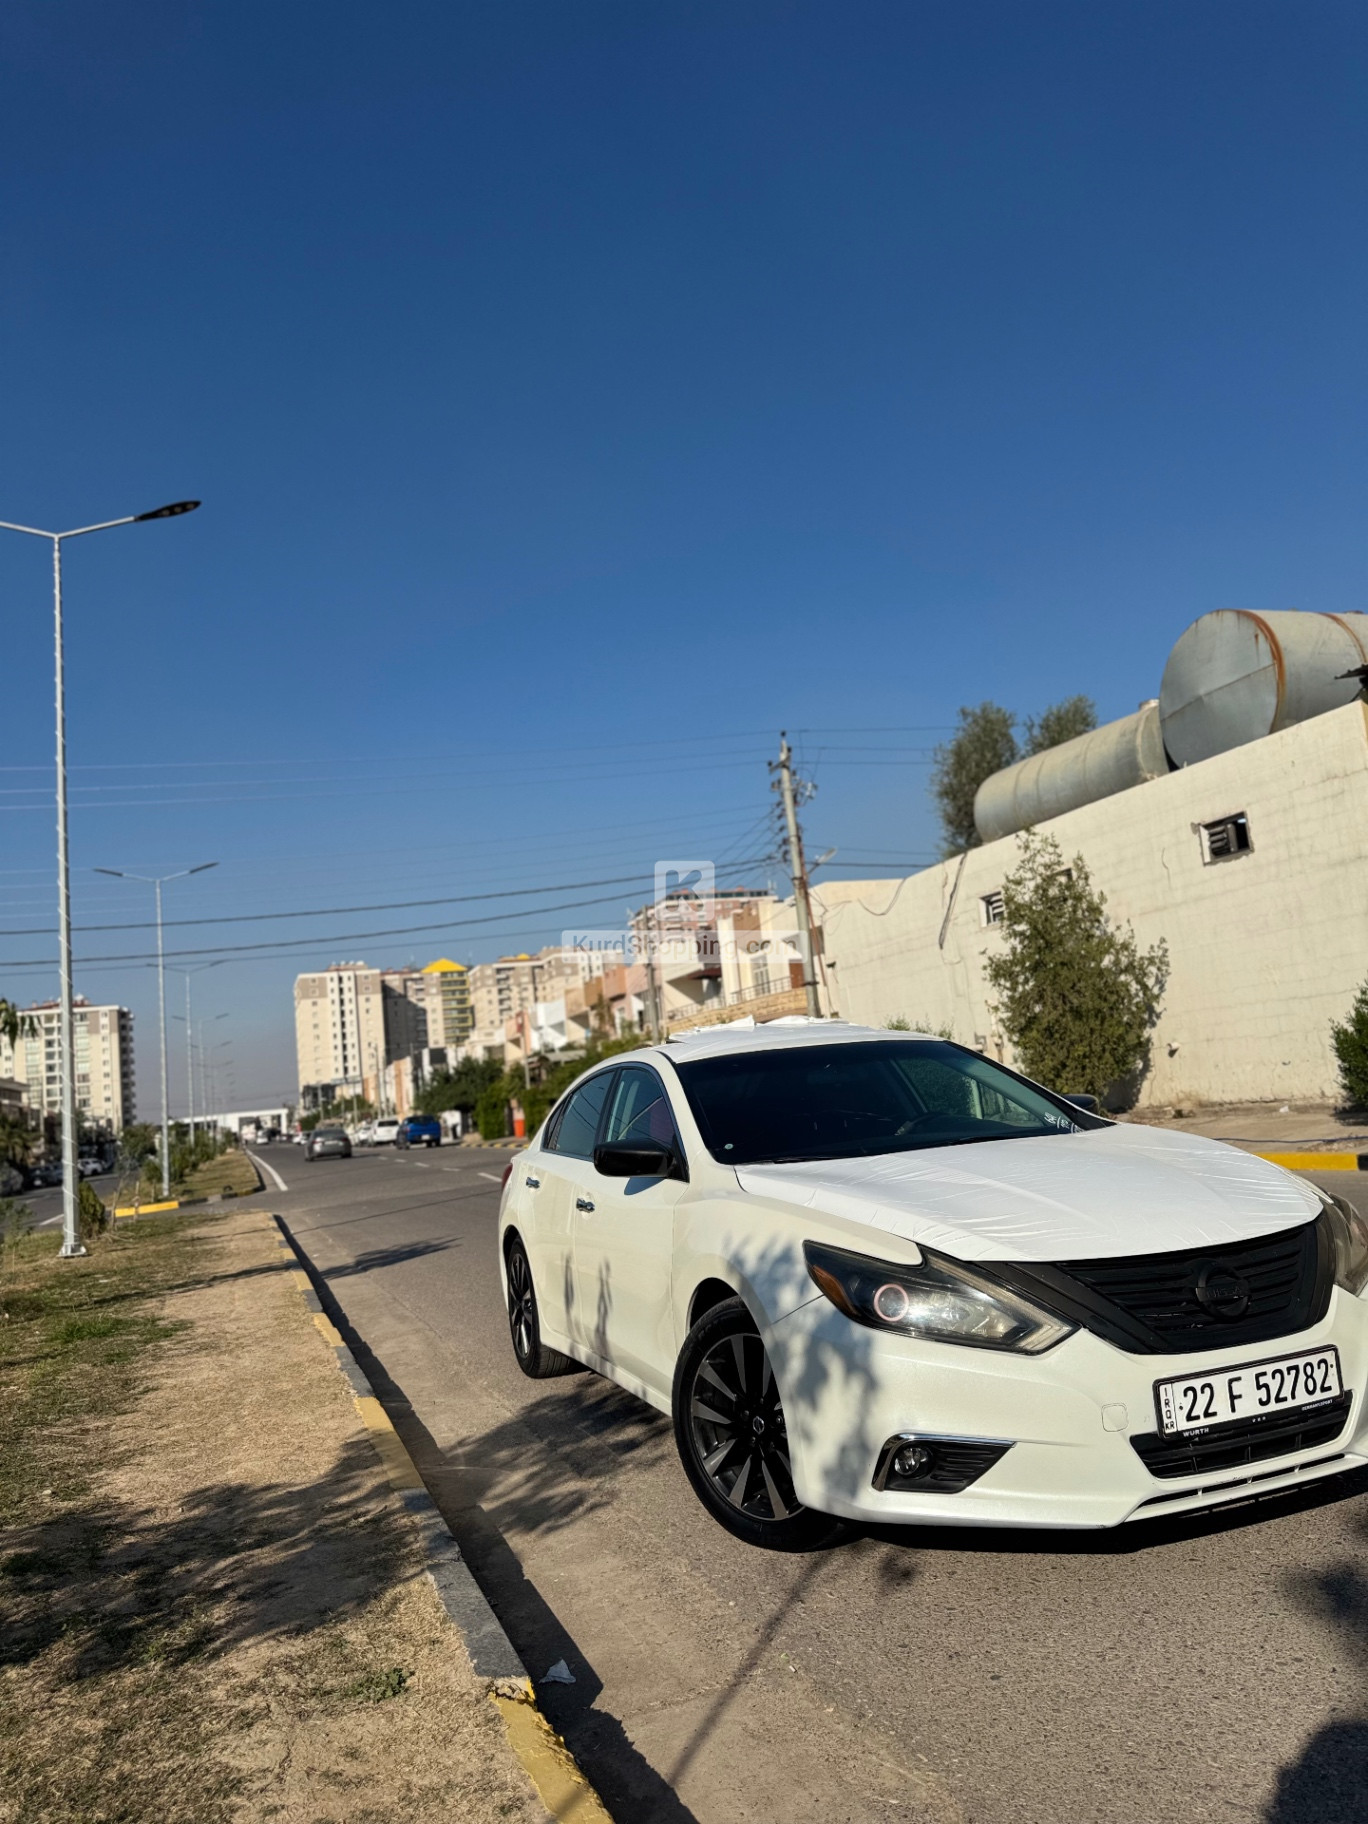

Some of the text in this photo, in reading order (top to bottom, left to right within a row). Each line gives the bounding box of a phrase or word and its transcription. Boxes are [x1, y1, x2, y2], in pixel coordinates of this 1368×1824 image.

[1183, 1358, 1333, 1422] 22 F 52782
[1165, 1420, 1175, 1430] KR
